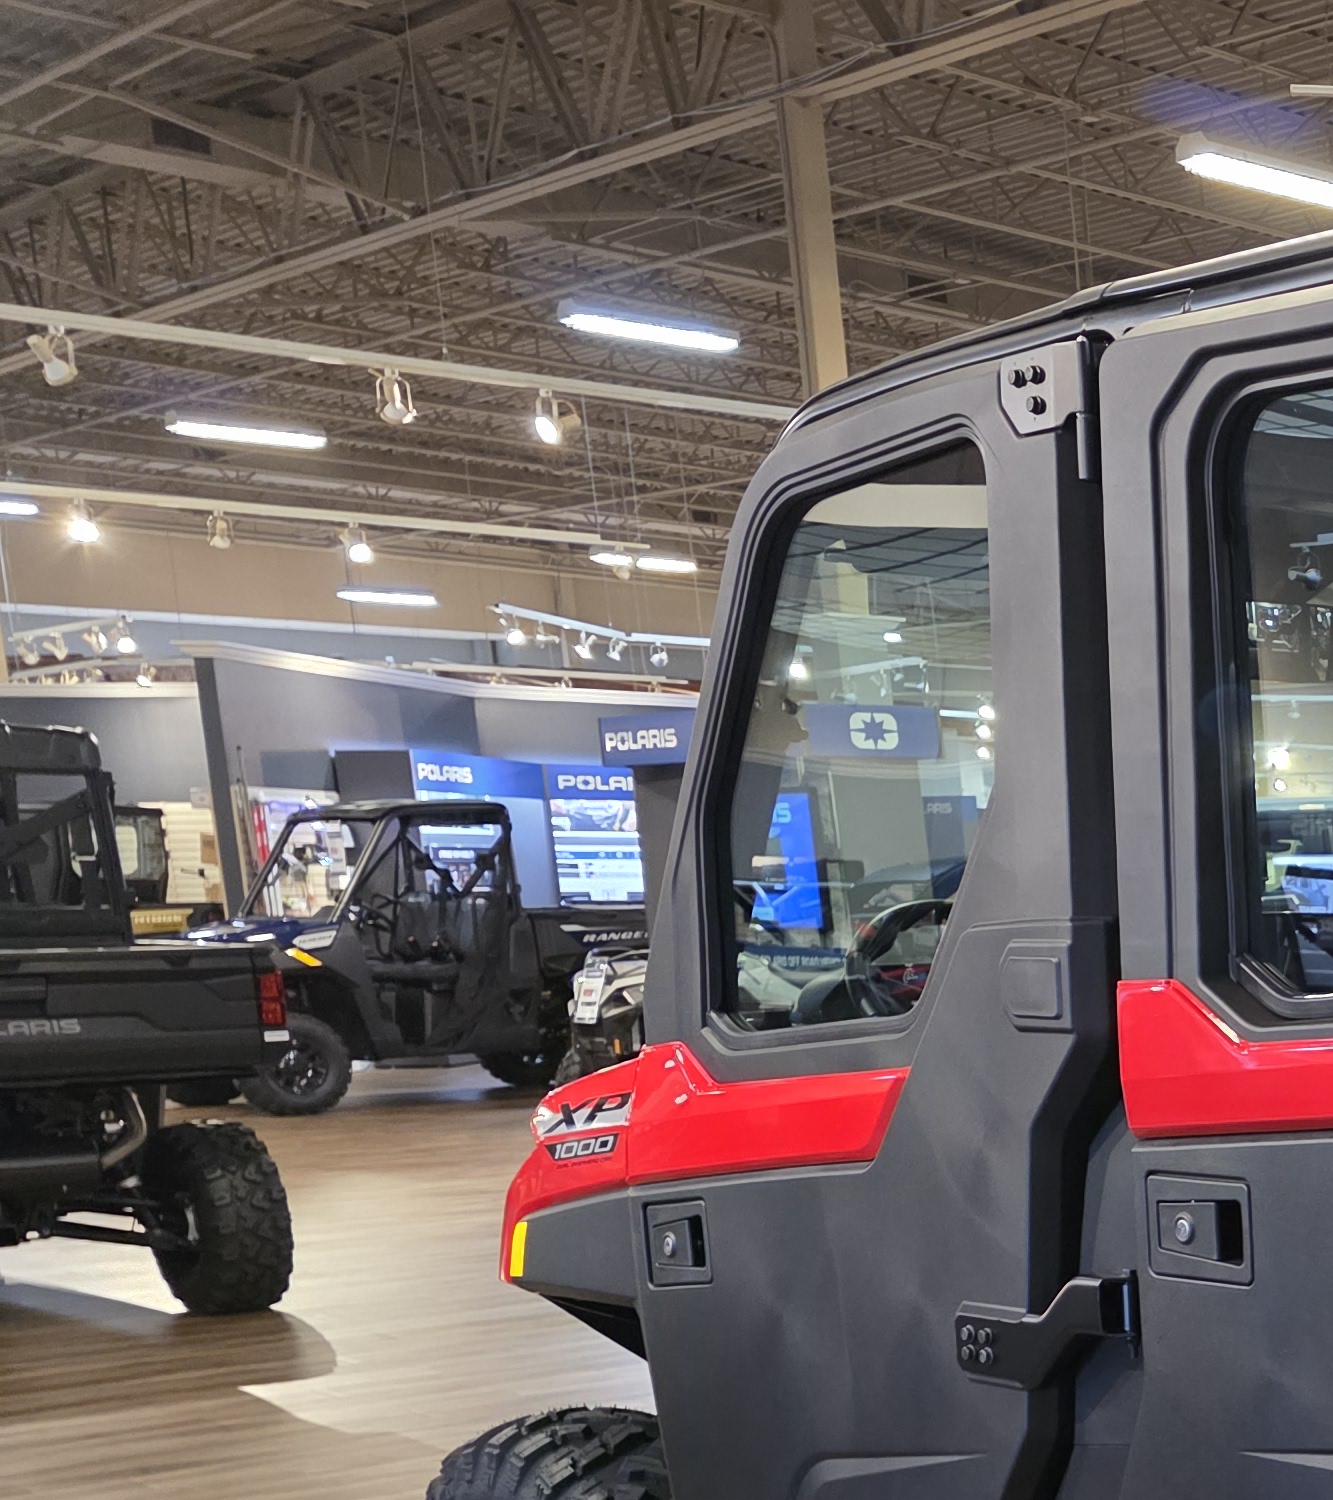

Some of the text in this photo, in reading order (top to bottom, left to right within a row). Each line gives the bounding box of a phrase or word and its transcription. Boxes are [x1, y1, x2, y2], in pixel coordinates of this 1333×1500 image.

[605, 728, 677, 752] POLARIS
[417, 763, 473, 783] POLARIS
[542, 1092, 632, 1135] XP
[554, 1135, 614, 1160] 1000
